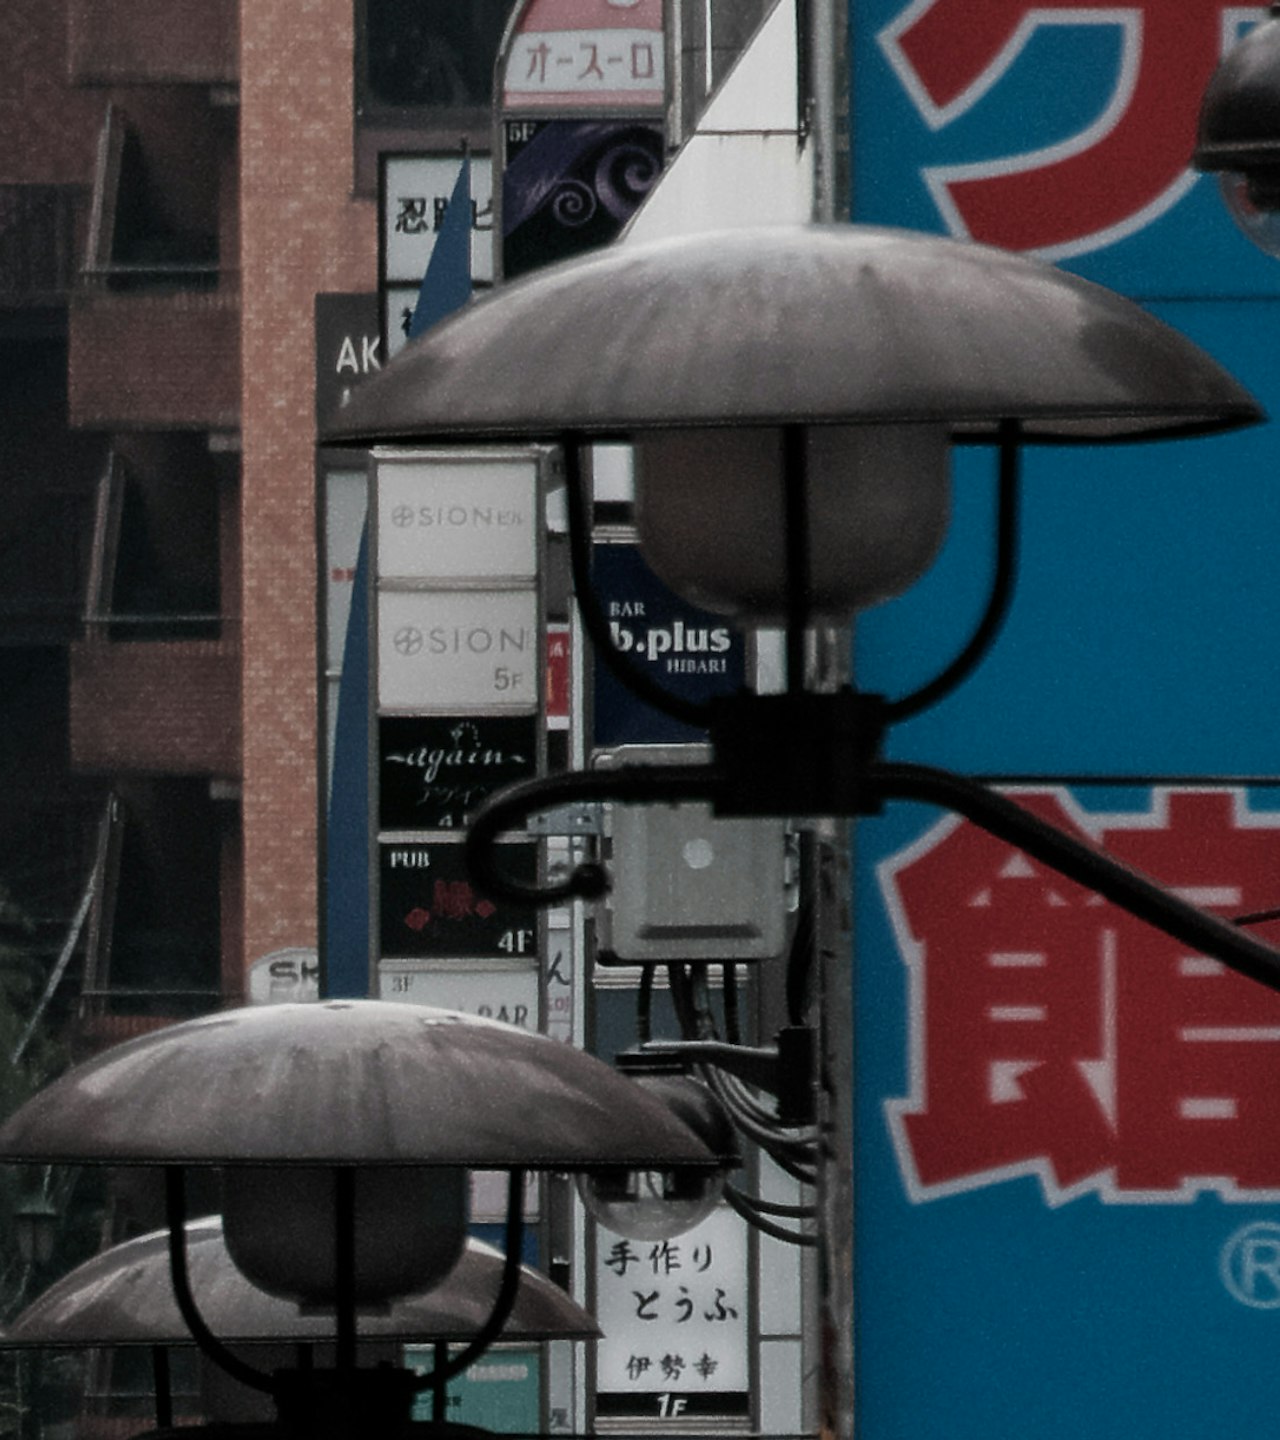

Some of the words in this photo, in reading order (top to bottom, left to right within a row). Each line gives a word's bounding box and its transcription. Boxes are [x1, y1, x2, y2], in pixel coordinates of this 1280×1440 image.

[609, 601, 646, 617] BAR
[608, 621, 732, 661] b.plus
[666, 658, 728, 674] HIBARI
[494, 668, 522, 690] 5F
[390, 851, 431, 869] PUB
[497, 929, 535, 953] 4F
[604, 1241, 714, 1276] 手作り
[633, 1289, 739, 1323] とうふ
[656, 1393, 688, 1418] 1F
